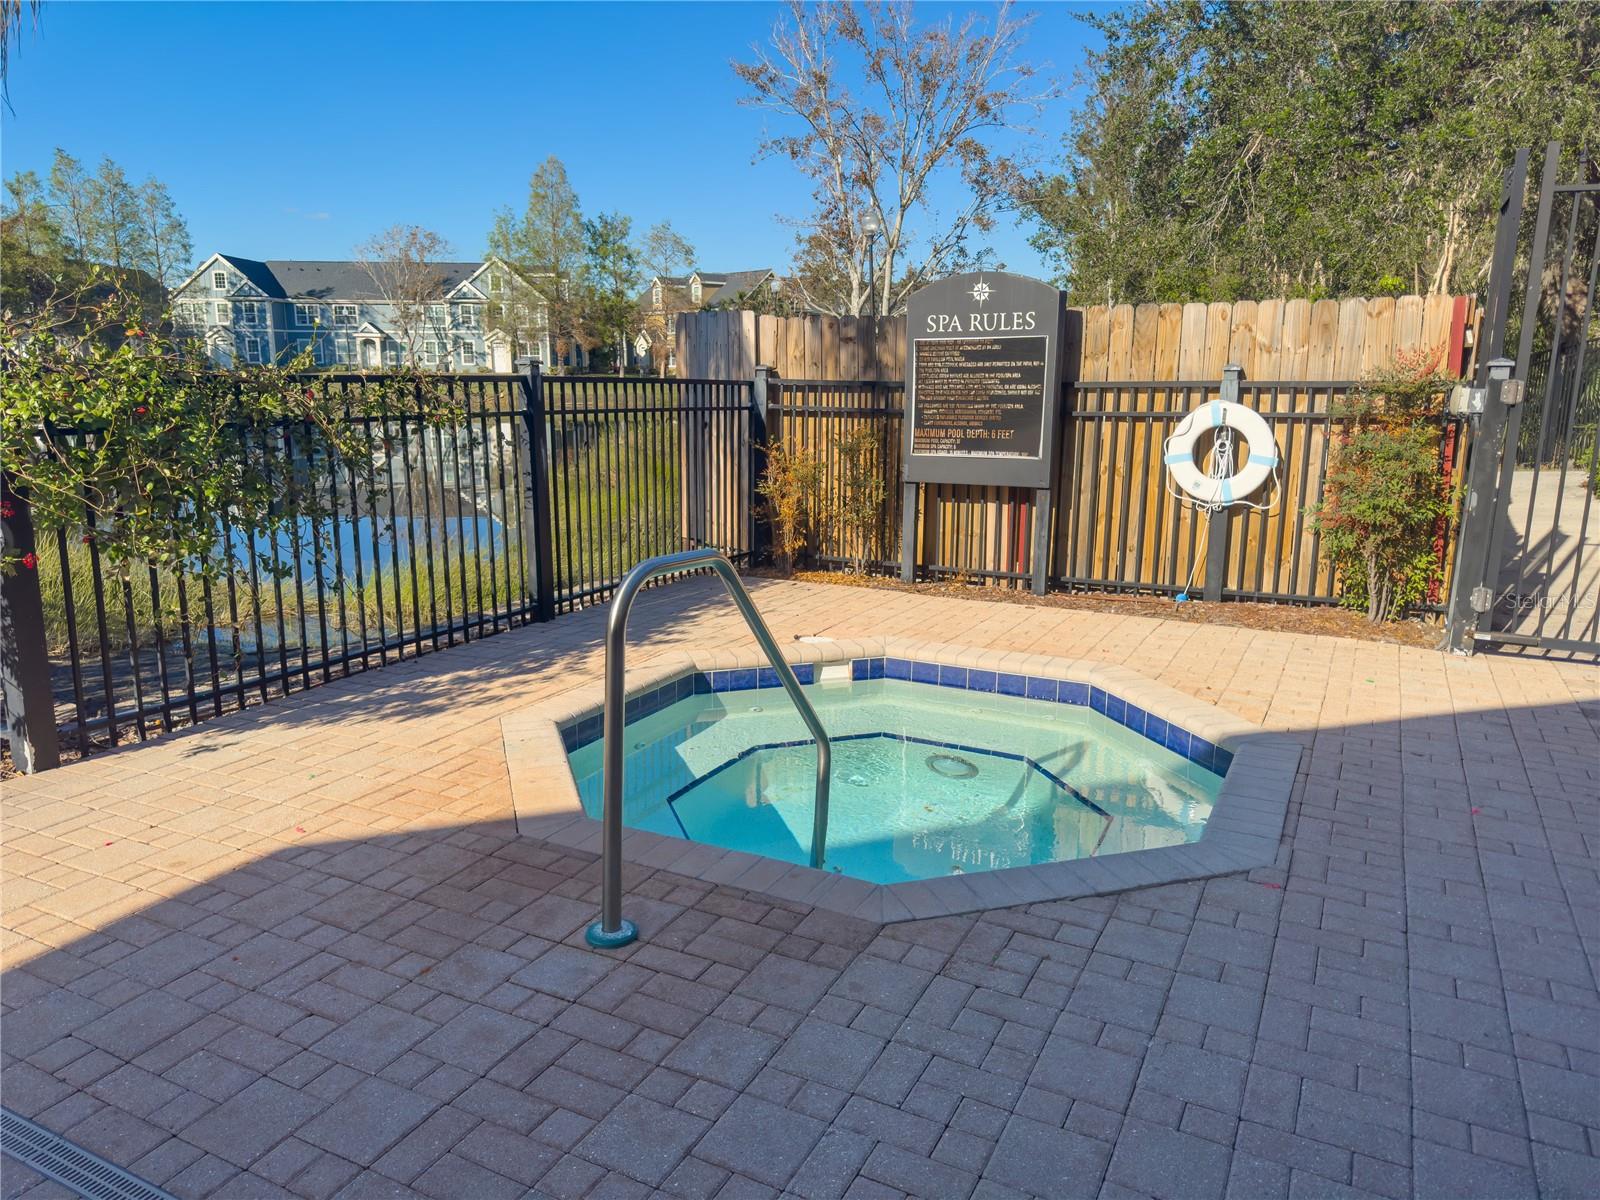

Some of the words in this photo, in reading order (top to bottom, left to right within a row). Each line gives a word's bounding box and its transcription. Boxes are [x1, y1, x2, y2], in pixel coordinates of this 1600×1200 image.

[926, 314, 963, 333] SPA
[969, 311, 1036, 332] RULES
[914, 428, 946, 438] MAXIMUM
[947, 428, 965, 438] POOL
[966, 429, 990, 439] DEPTH:
[997, 429, 1015, 440] FEET
